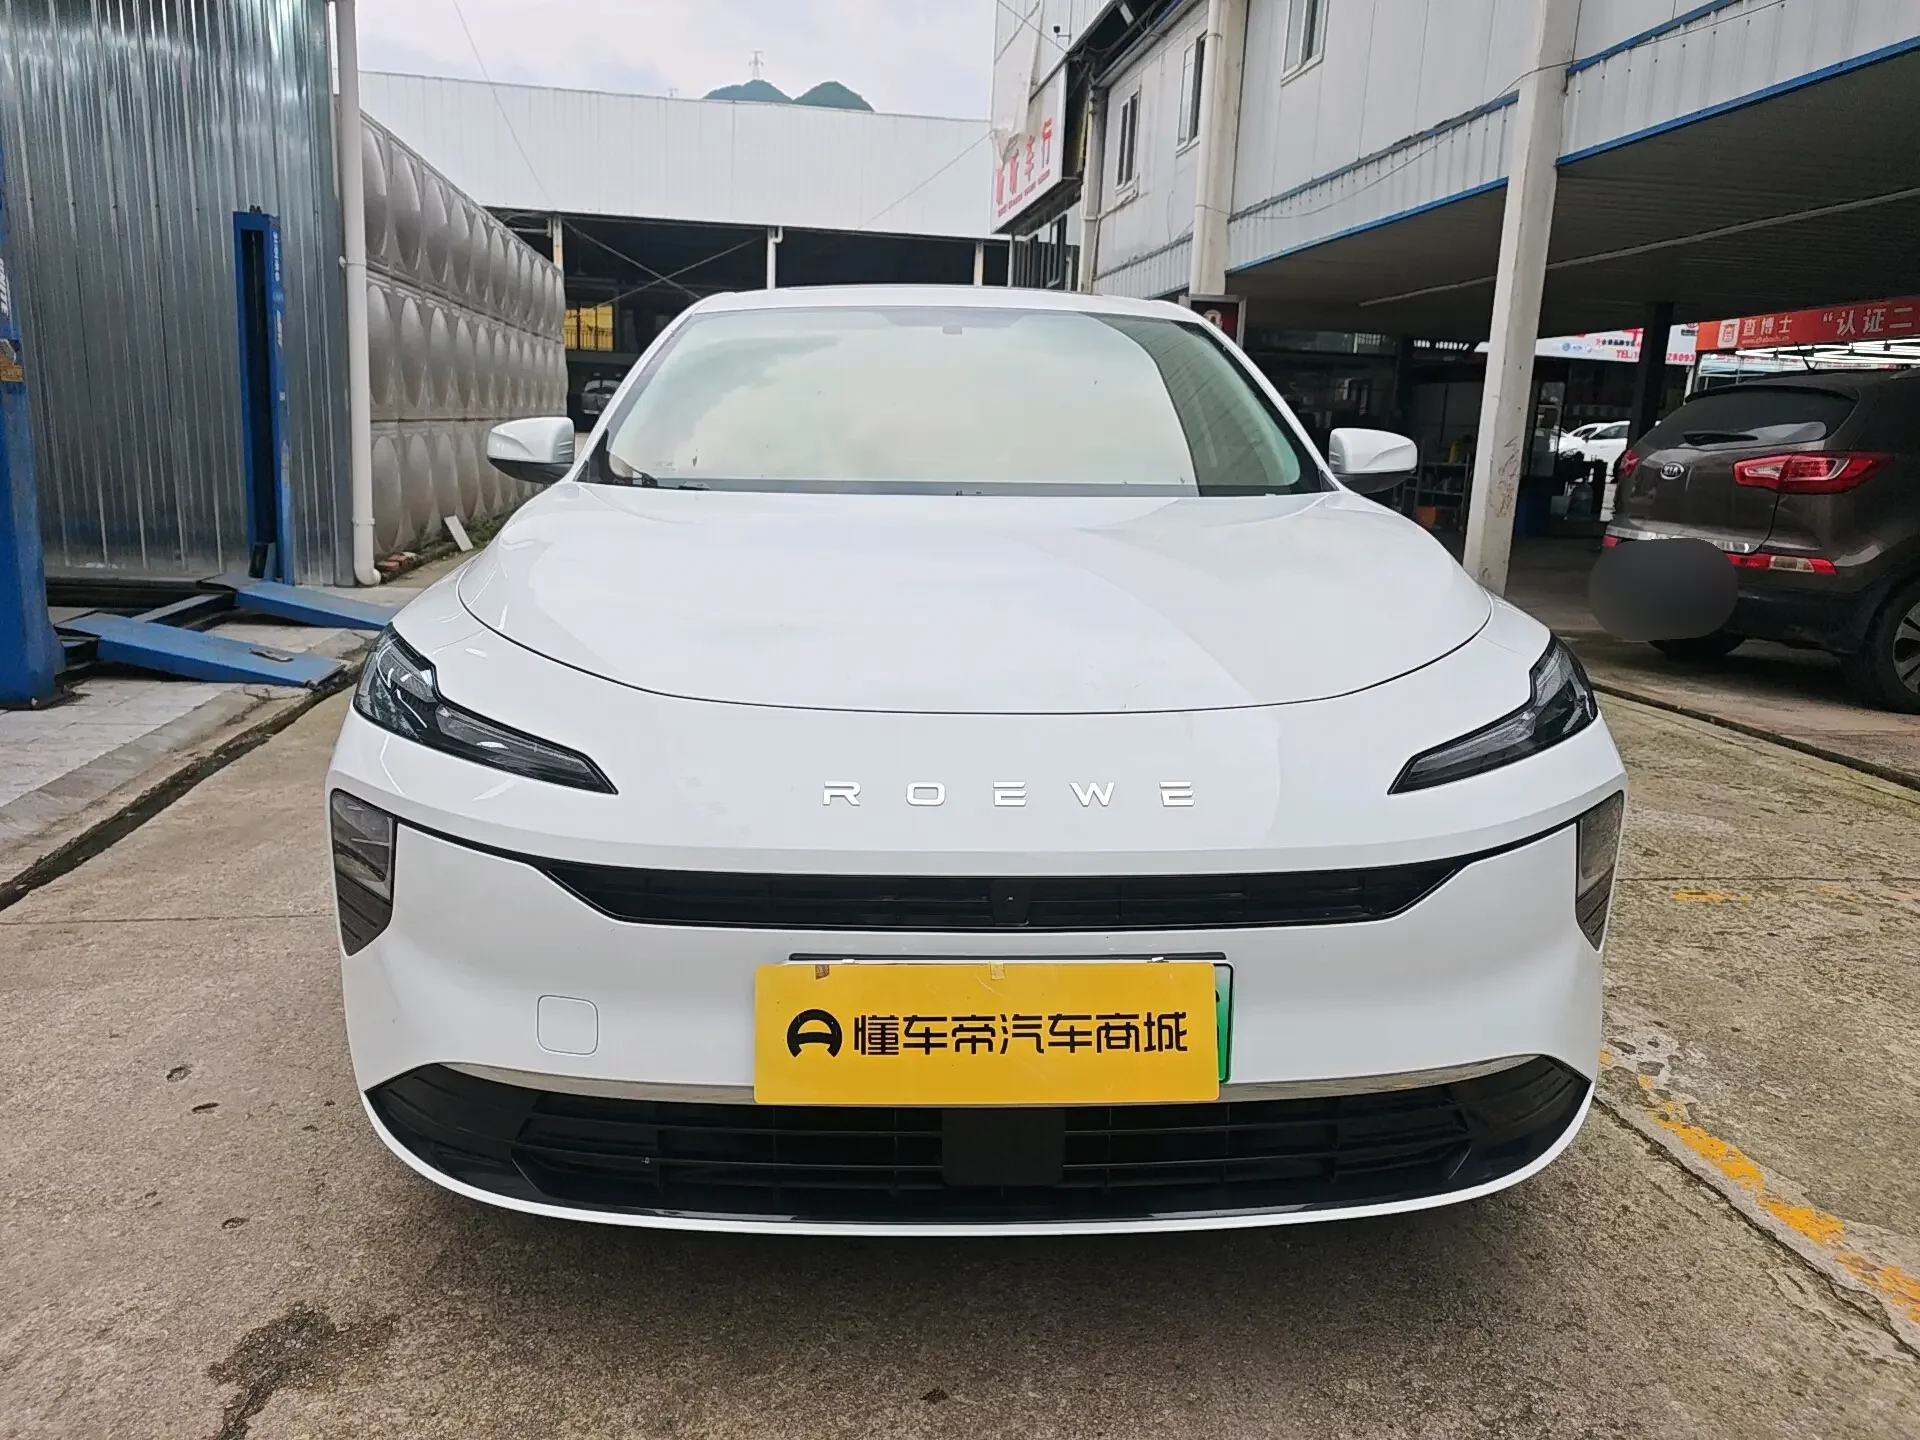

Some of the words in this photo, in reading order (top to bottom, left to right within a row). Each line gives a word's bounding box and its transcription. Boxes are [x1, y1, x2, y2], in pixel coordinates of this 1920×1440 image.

[1742, 315, 1793, 337] 查博士
[822, 781, 1195, 807] ROEWE
[853, 1011, 1189, 1057] 懂车帝汽车商城
